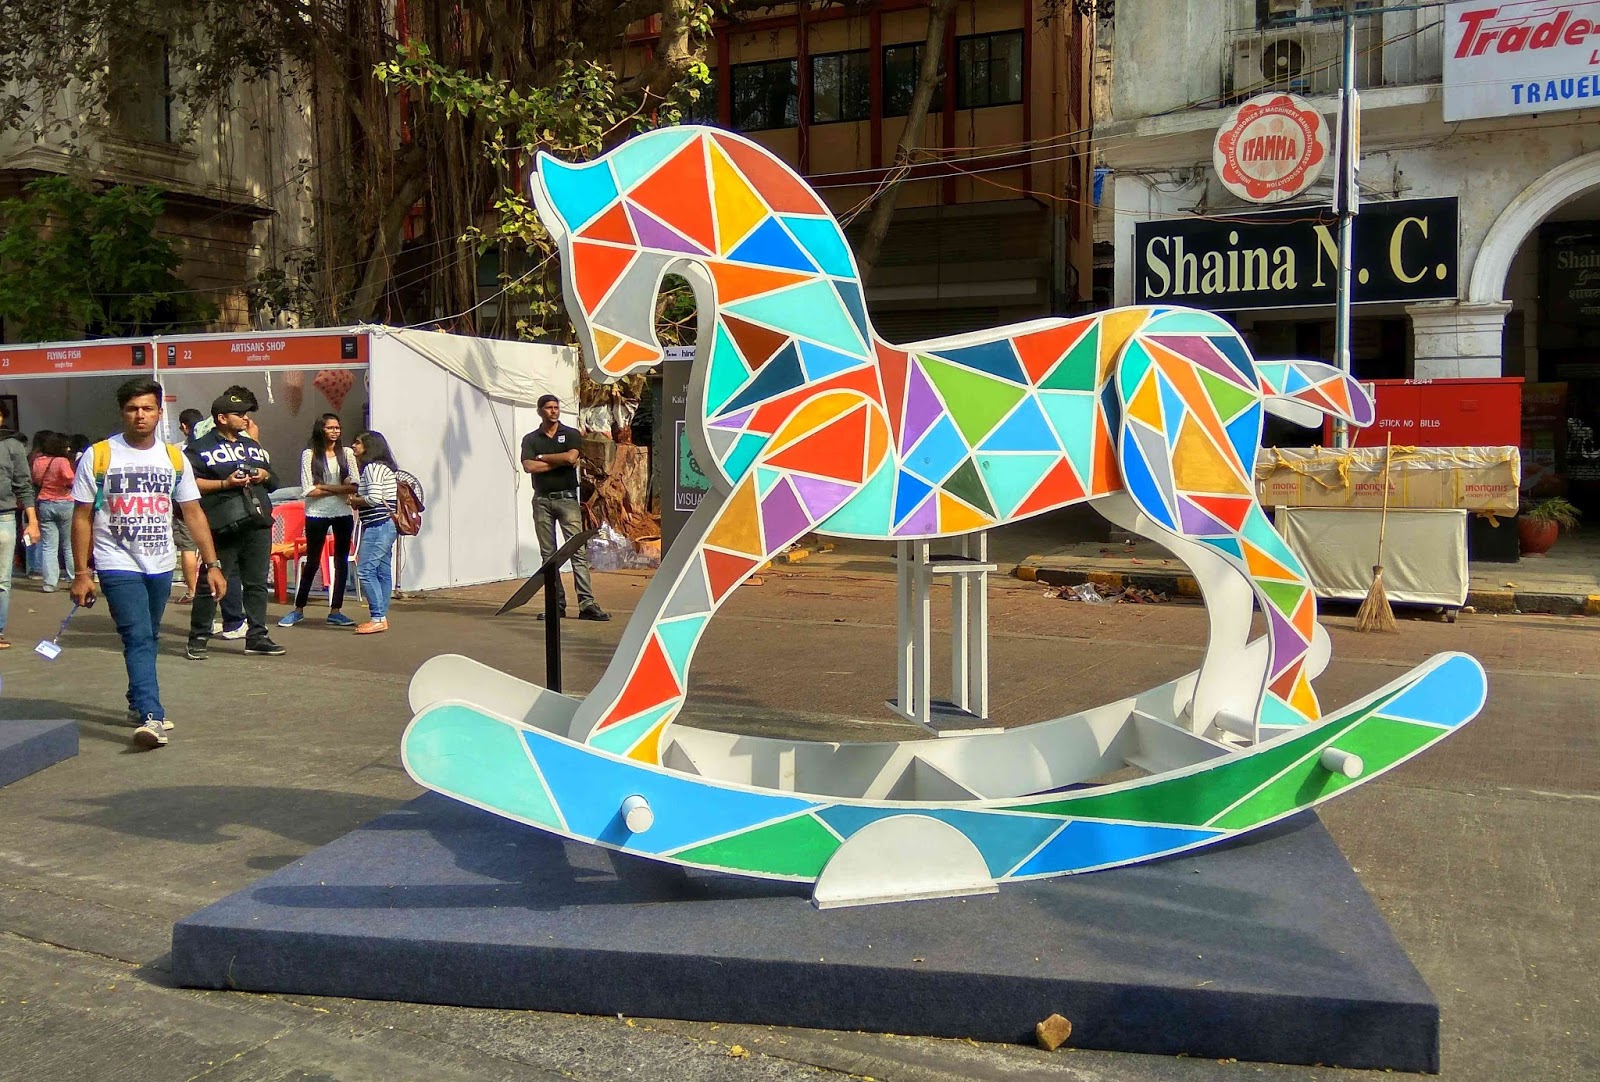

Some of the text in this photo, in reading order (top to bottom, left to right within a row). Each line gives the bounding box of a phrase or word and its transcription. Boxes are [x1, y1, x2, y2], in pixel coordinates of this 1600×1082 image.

[1511, 75, 1600, 105] TRAVEL
[1265, 106, 1299, 119] MACHINERY
[1230, 112, 1258, 146] ACCESSORIES
[1242, 135, 1296, 161] ITAMMA
[1228, 147, 1238, 171] TEXTILE
[1266, 165, 1304, 188] ASSOCIATION
[1145, 230, 1298, 298] Shaina
[1389, 216, 1447, 284] C.
[2, 350, 81, 367] 23 FLYING FISH
[183, 341, 286, 360] 22 ARTISANS SHOP
[1379, 419, 1401, 428] STICK
[1420, 419, 1441, 428] BILLS
[107, 473, 149, 494] IF
[107, 496, 171, 515] WHO
[677, 492, 706, 505] VISUA
